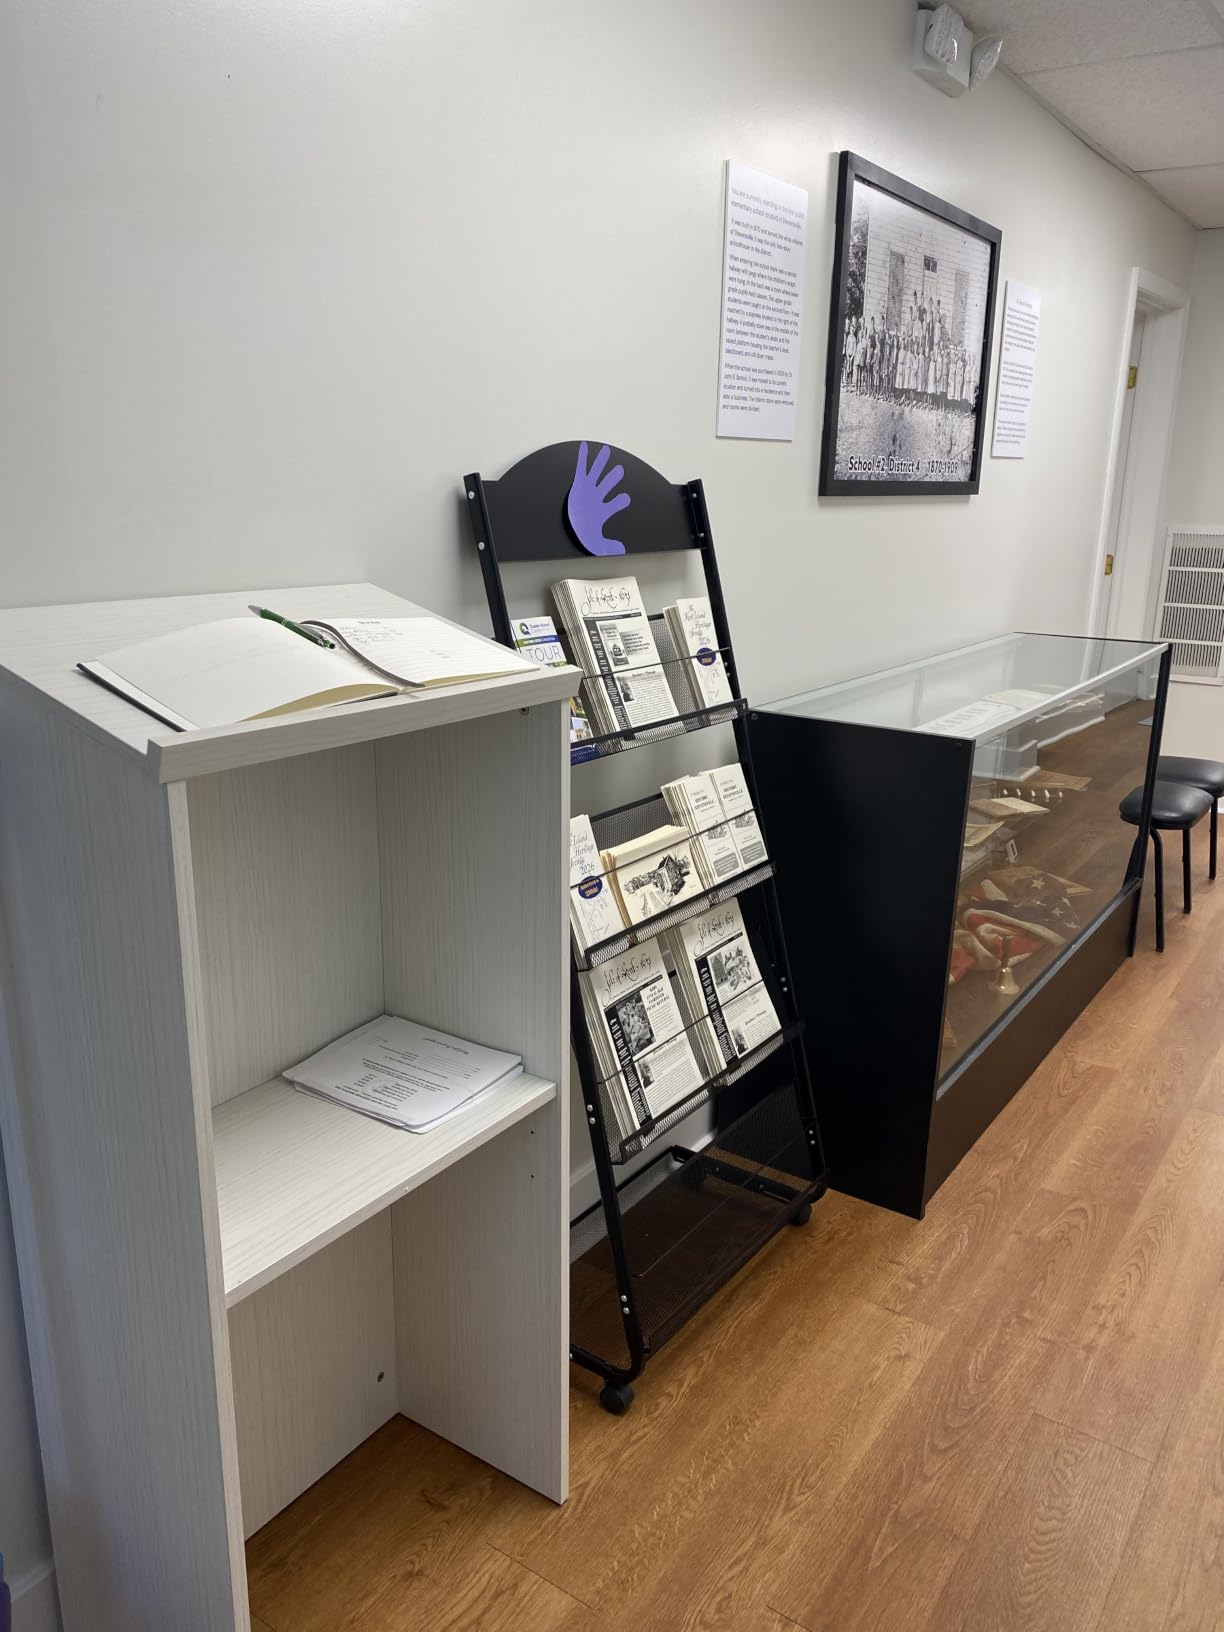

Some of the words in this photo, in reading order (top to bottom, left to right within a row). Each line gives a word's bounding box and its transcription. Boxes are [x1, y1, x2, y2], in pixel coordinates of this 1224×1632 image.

[848, 456, 874, 472] School
[888, 458, 914, 474] District
[915, 461, 920, 474] 4
[525, 646, 561, 662] TOUR
